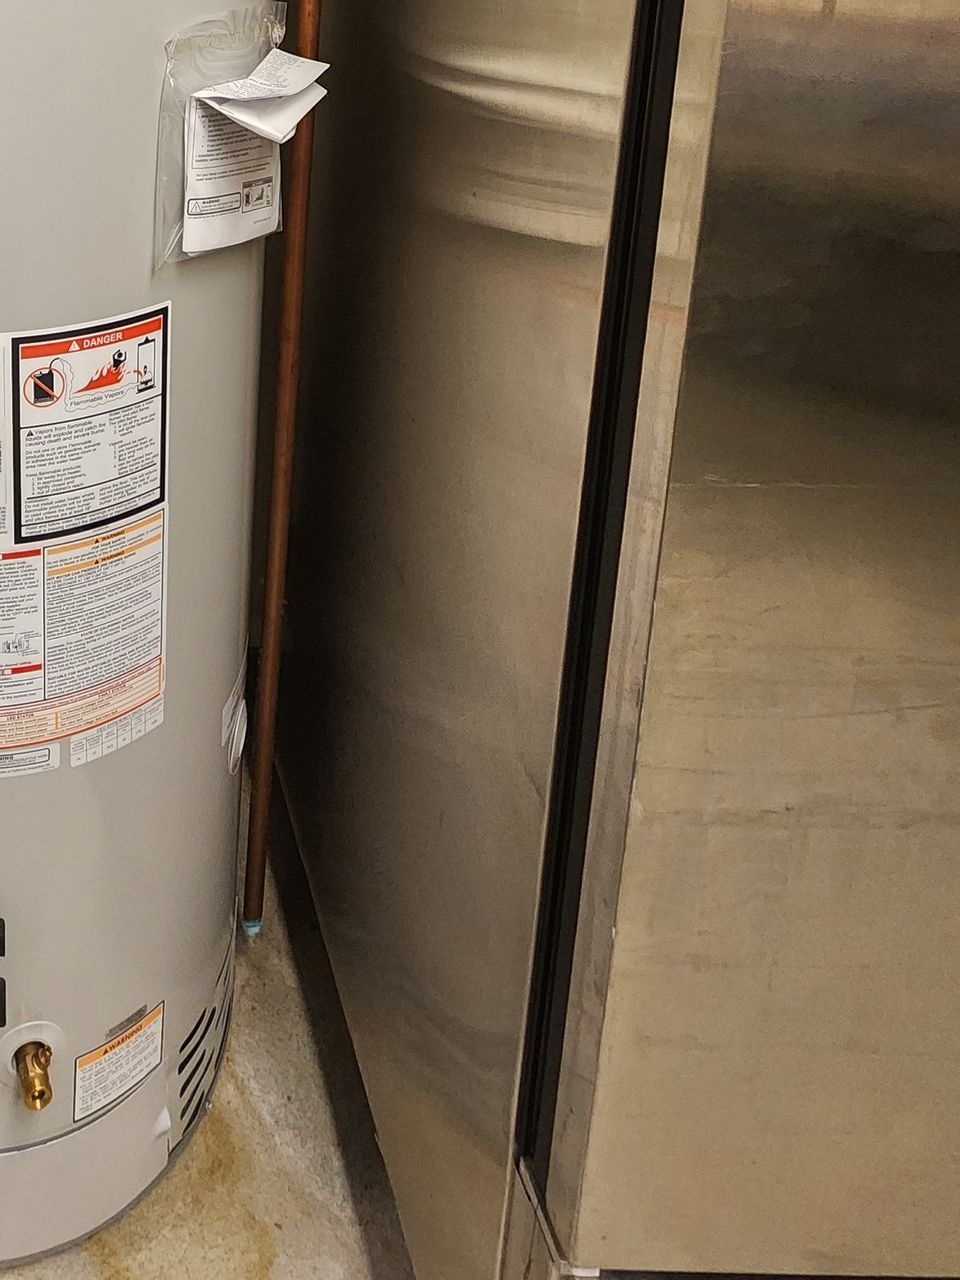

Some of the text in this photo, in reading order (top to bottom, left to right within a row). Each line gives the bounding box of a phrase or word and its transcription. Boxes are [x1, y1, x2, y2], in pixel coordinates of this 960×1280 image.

[83, 332, 124, 349] DANGER
[70, 390, 124, 405] Flammable Vapors
[101, 529, 125, 542] WARNING
[101, 550, 125, 563] WARNING
[109, 1026, 143, 1052] WARNING
